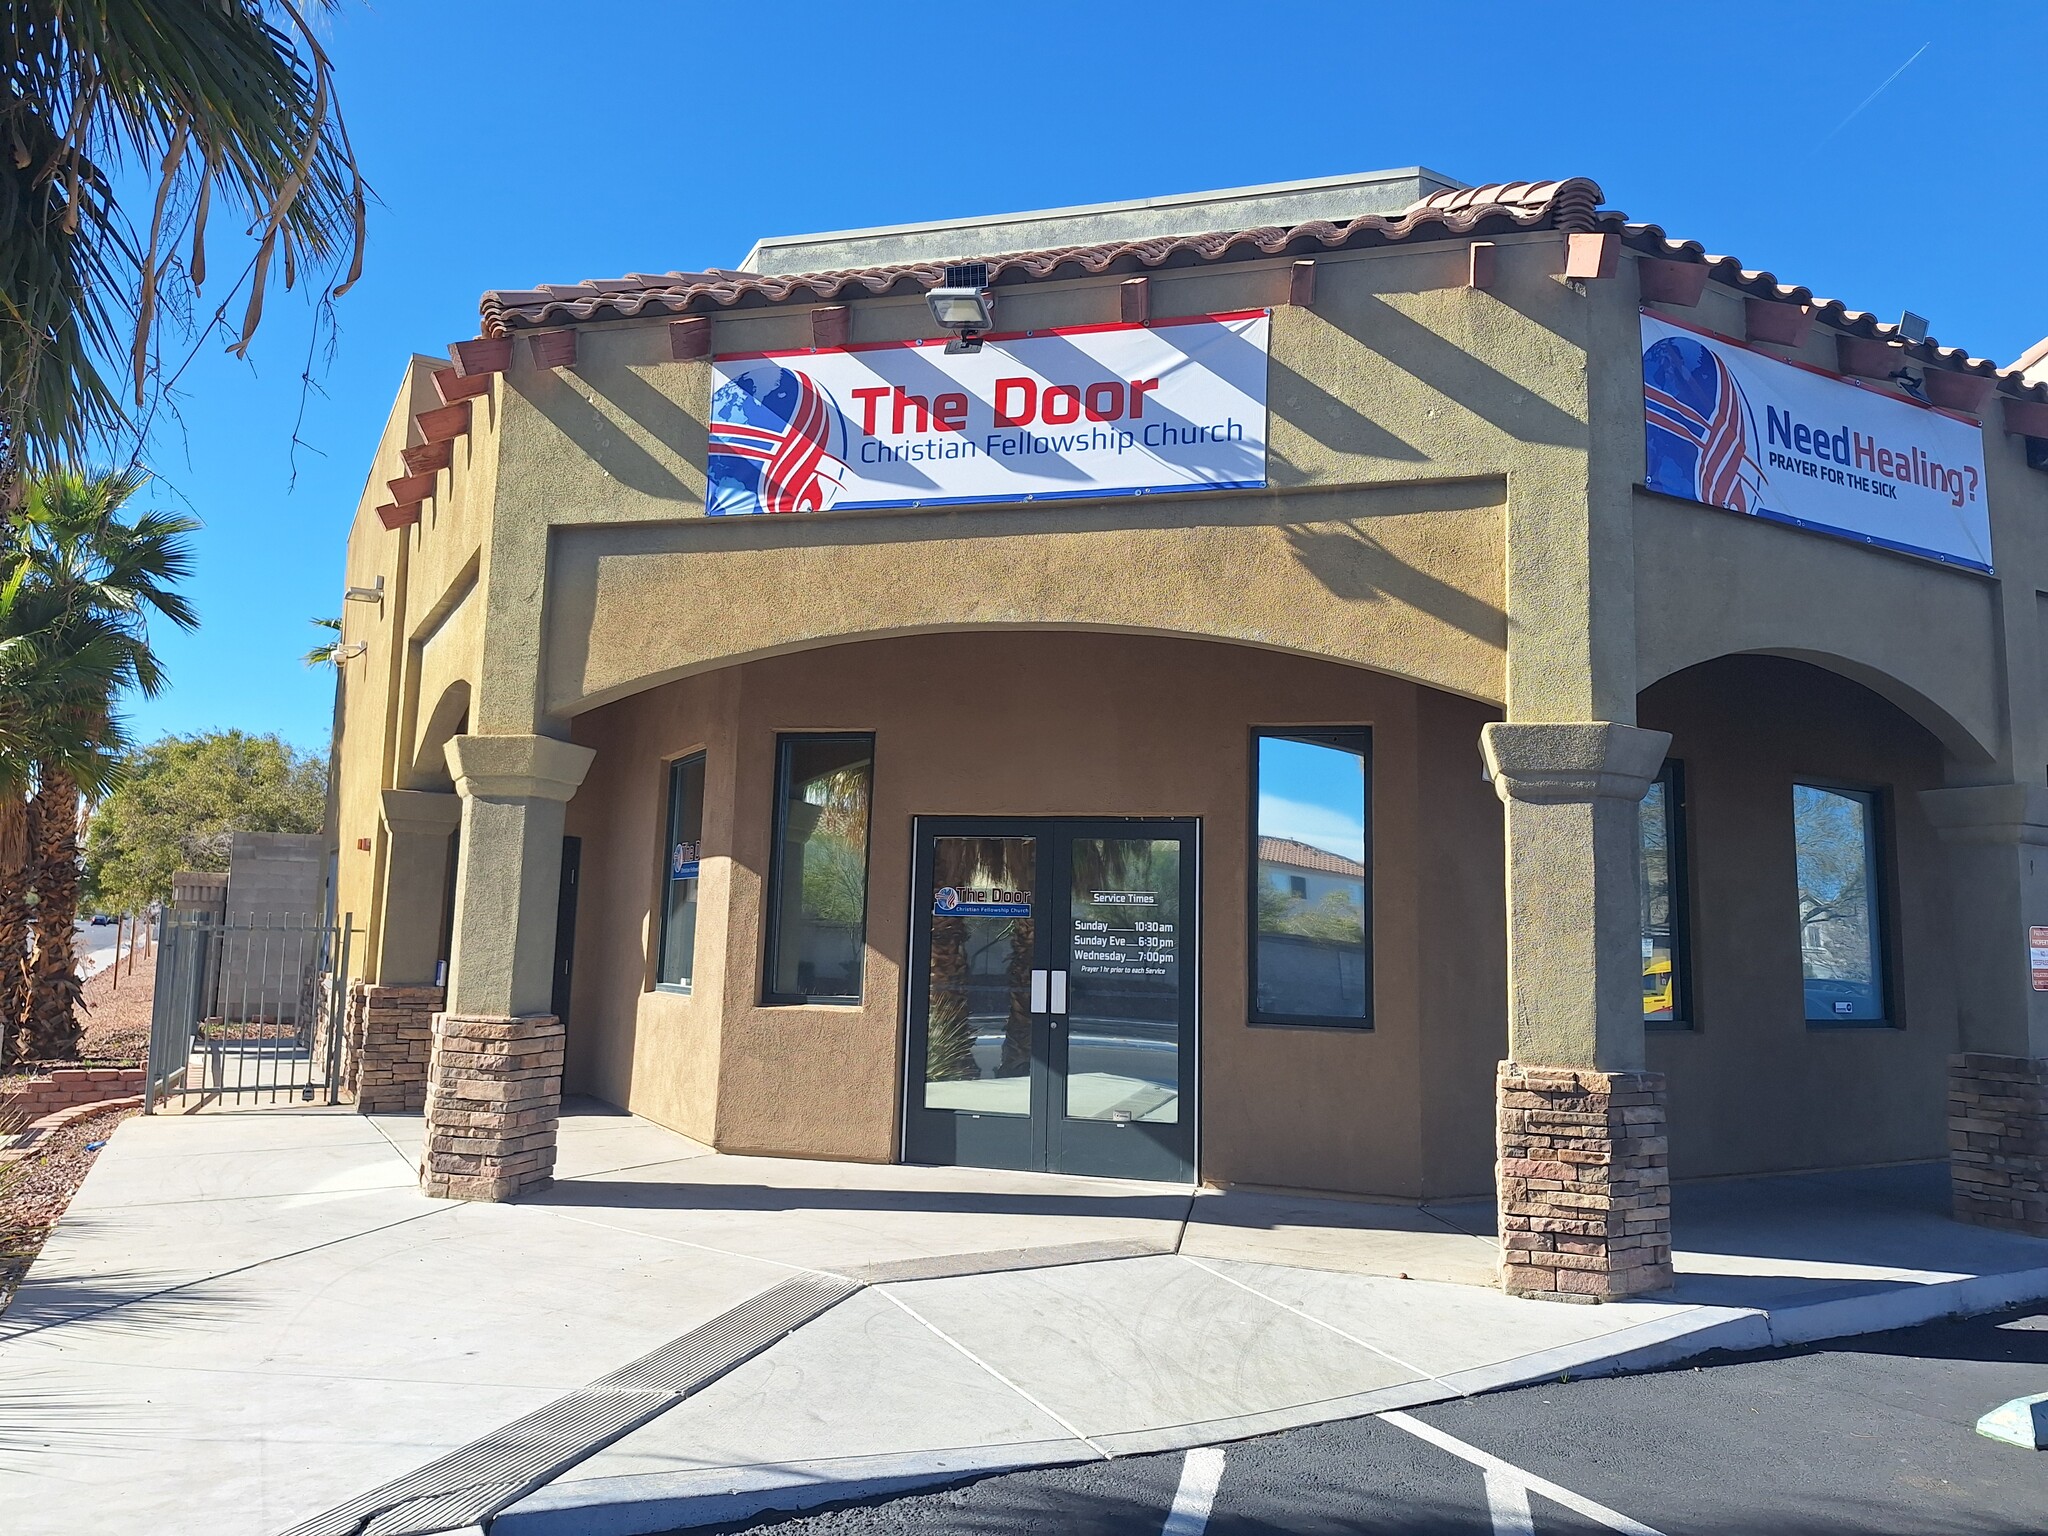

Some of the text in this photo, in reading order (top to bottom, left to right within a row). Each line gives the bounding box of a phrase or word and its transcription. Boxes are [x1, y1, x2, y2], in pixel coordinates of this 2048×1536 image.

[851, 377, 1159, 436] The Door
[860, 417, 1243, 464] Christian Fellowship Church
[1769, 451, 1898, 500] PRAYER FOR THE SICK
[956, 887, 1031, 903] The Door
[1093, 893, 1154, 903] Service Times
[1075, 920, 1108, 933] Sunday
[1074, 935, 1107, 947] Sunday
[1109, 936, 1126, 946] Eve
[1074, 950, 1126, 963] Wednesday
[1081, 965, 1099, 974] Prayer
[1110, 966, 1124, 974] prior
[1145, 967, 1166, 975] Service
